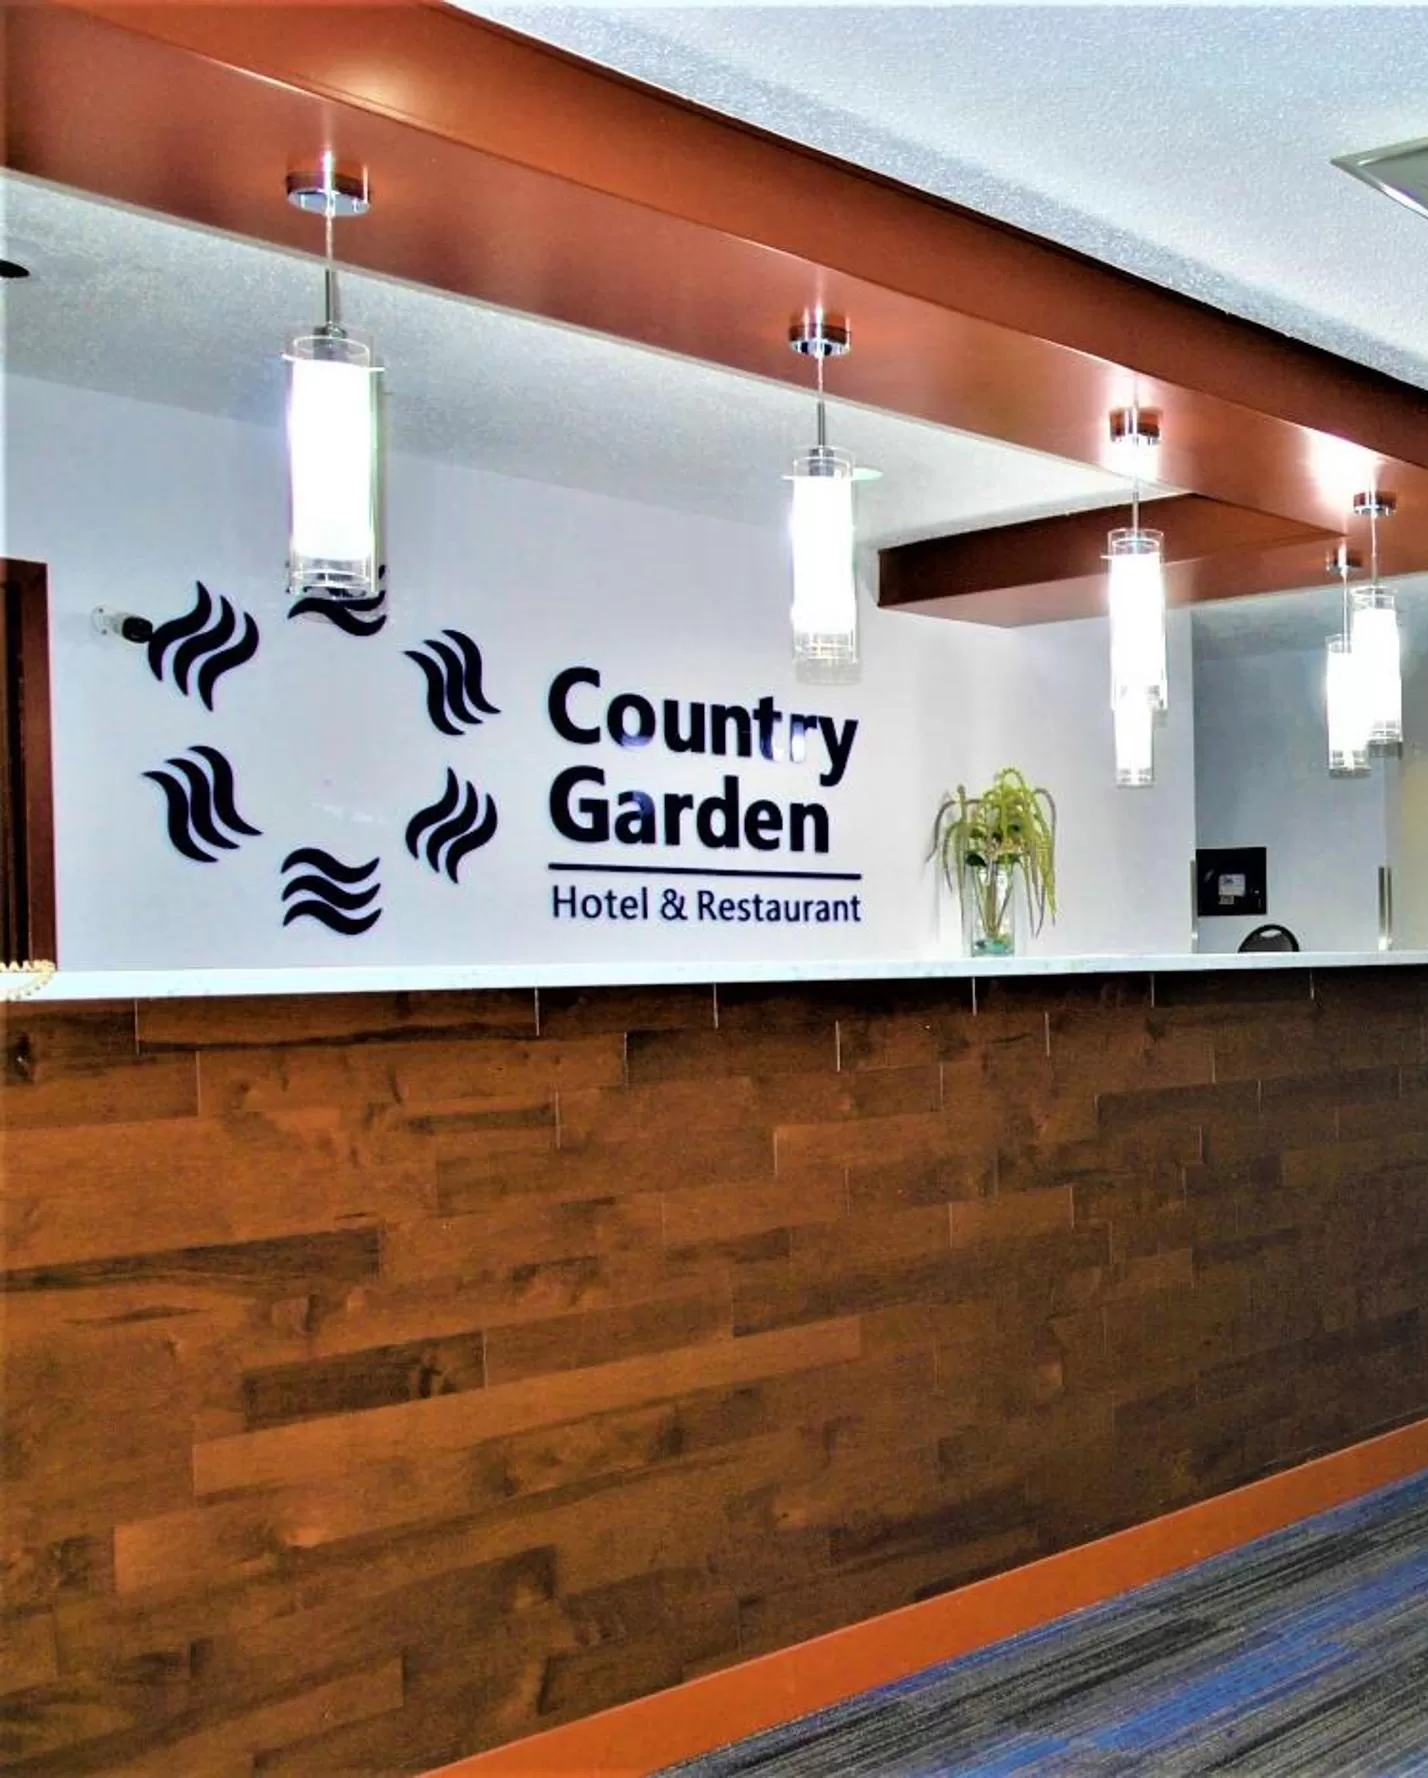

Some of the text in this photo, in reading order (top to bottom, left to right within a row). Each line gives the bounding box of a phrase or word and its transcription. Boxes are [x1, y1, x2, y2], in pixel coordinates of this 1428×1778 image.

[547, 666, 859, 787] Country
[549, 765, 829, 854] Garden
[552, 885, 862, 923] Hotel & Restaurant
